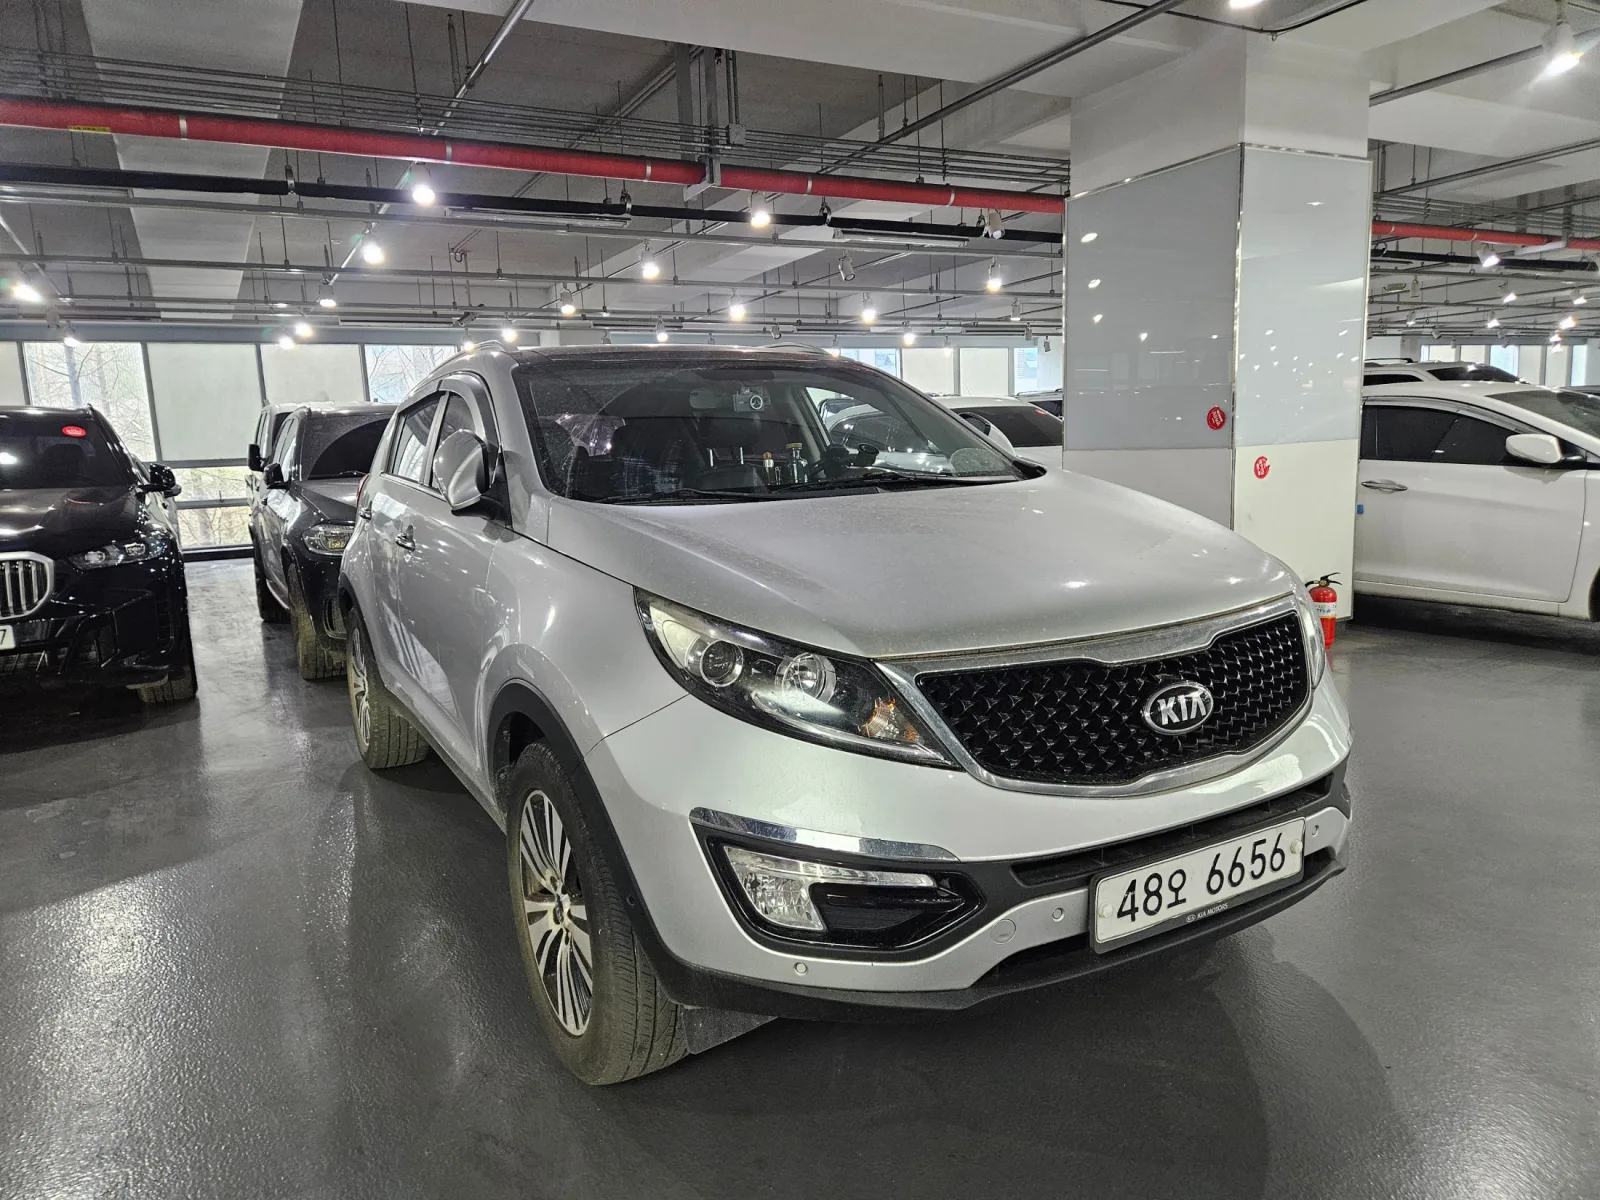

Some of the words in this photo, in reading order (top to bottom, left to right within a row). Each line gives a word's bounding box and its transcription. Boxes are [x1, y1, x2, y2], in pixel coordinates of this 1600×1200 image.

[1157, 688, 1206, 725] KIA
[1117, 869, 1187, 922] 48오
[1206, 833, 1285, 895] 6656
